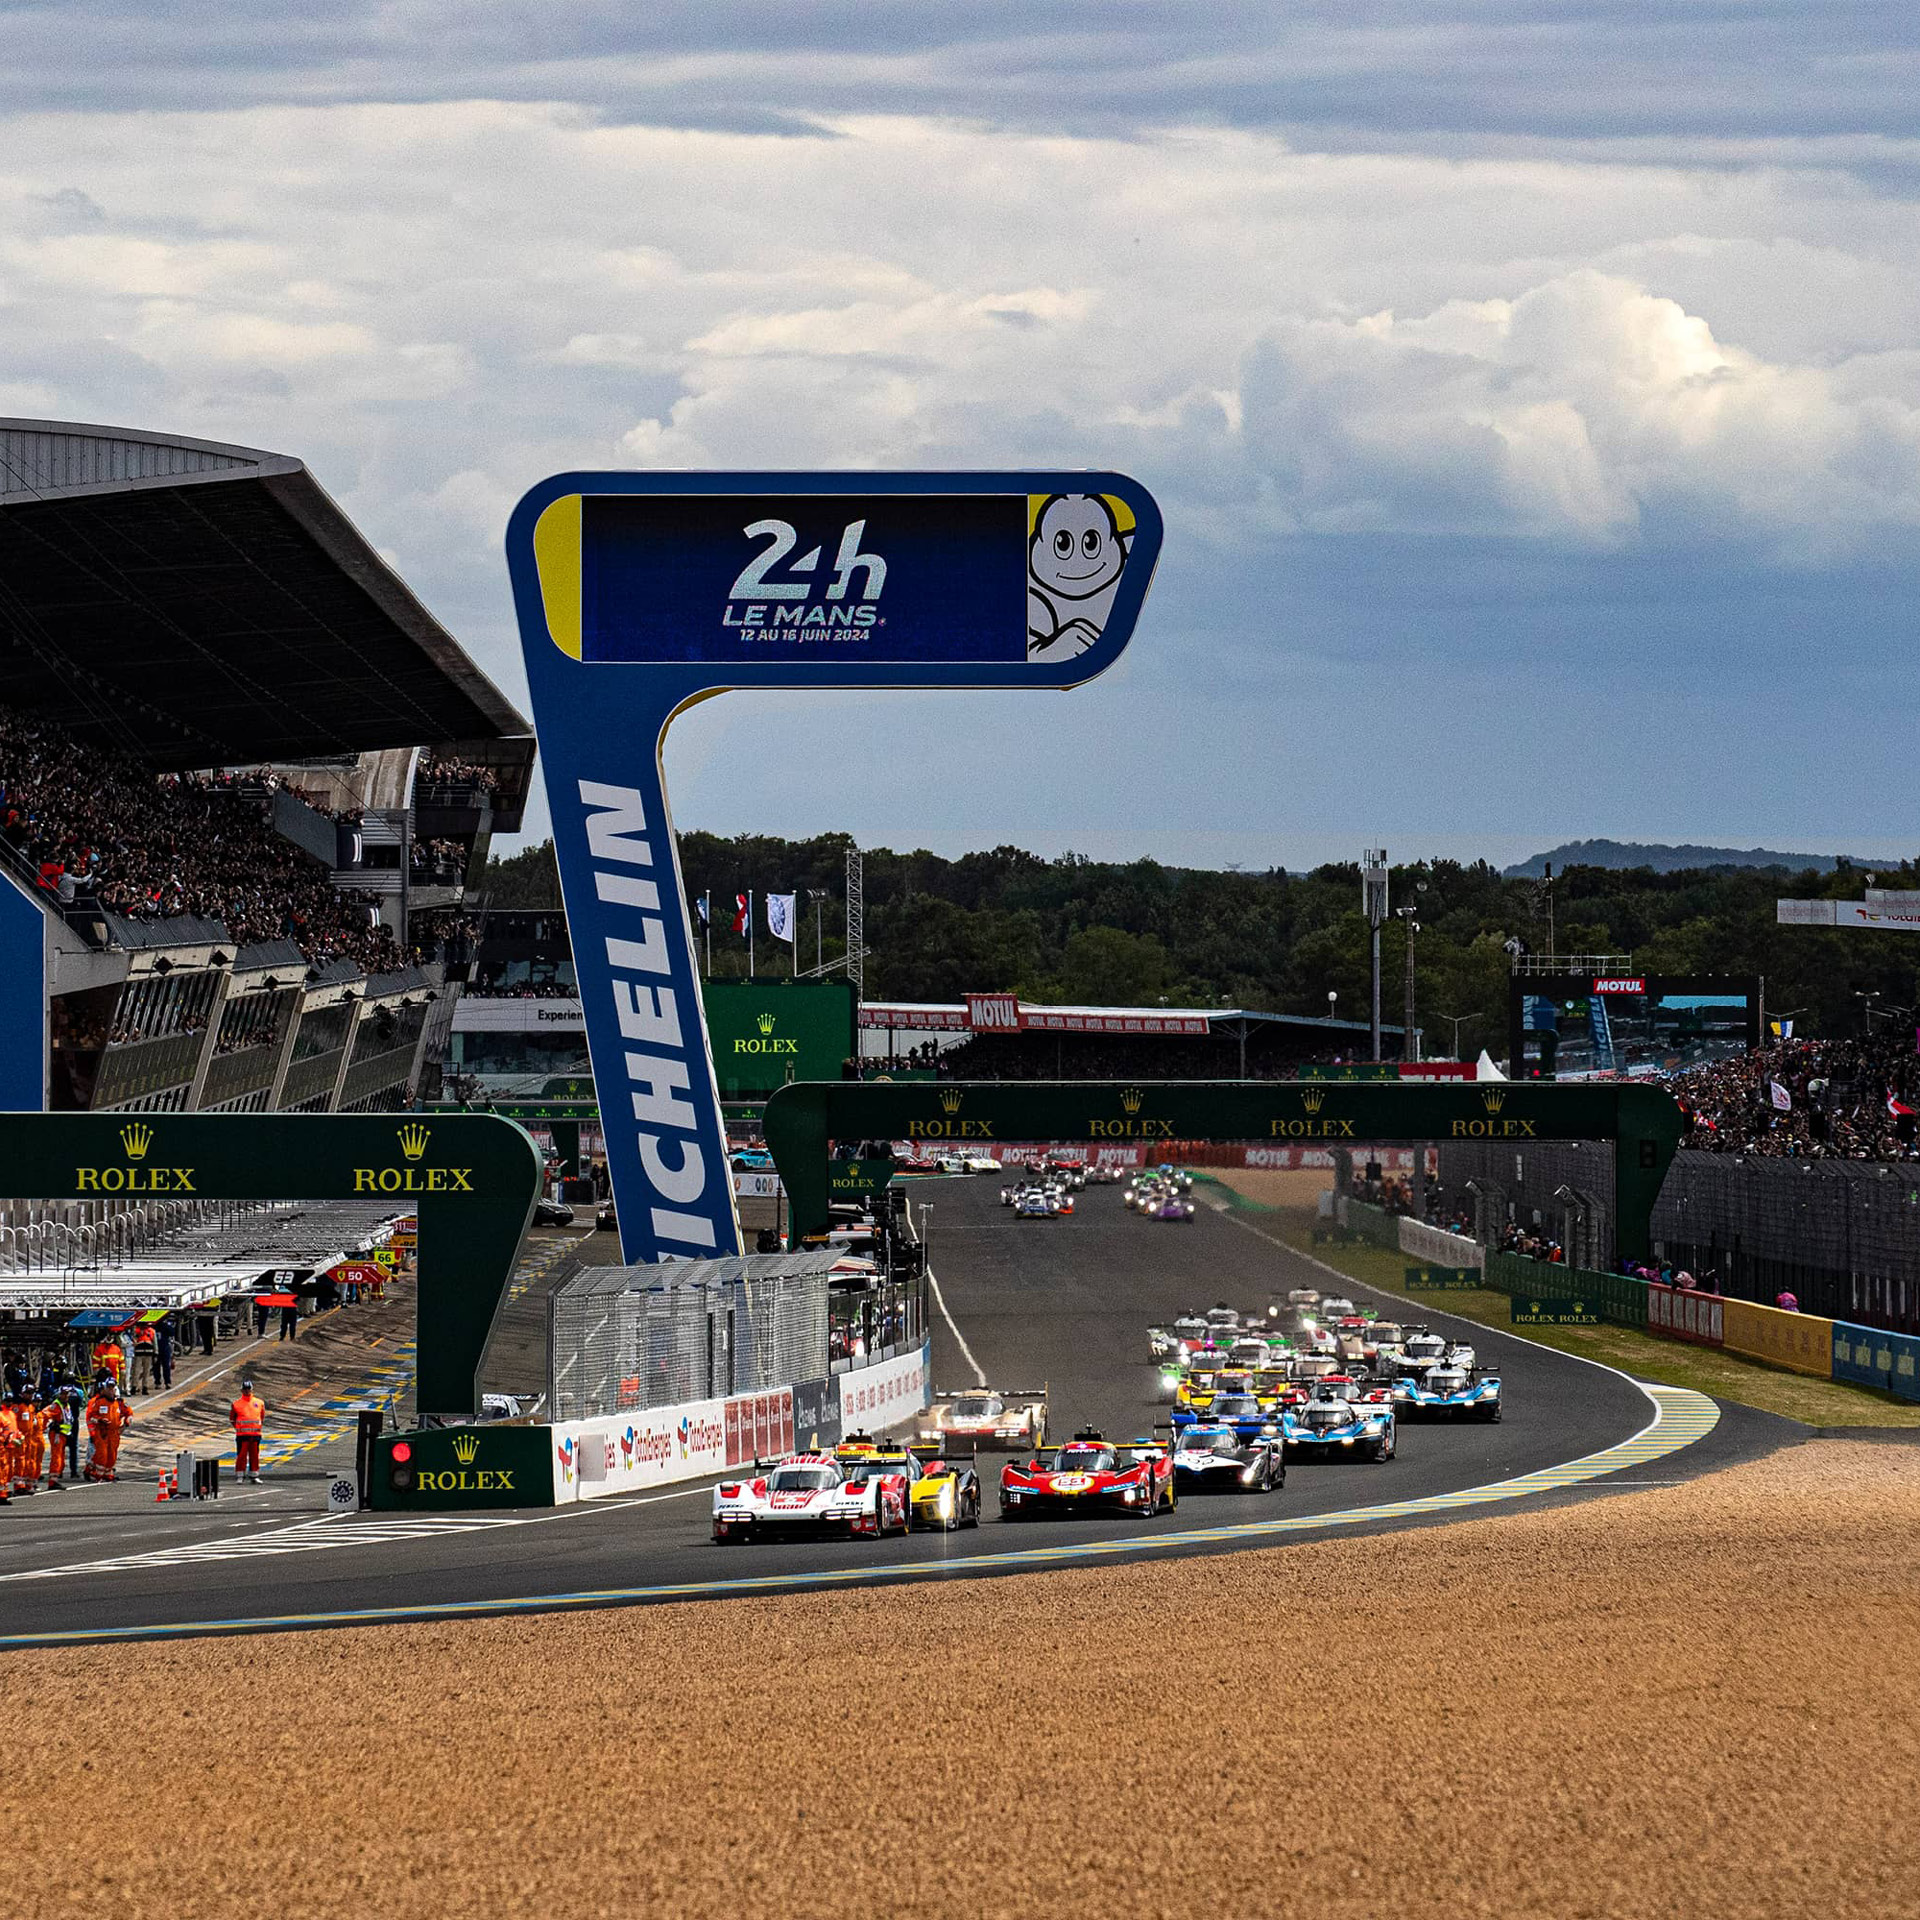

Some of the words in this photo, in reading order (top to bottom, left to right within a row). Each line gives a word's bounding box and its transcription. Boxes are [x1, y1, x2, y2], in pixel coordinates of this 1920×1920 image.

[722, 605, 768, 627] LE
[772, 605, 878, 627] MANS
[740, 629, 754, 641] 12
[757, 629, 779, 641] AU
[782, 629, 797, 641] 16
[799, 629, 831, 643] JUIN
[833, 629, 870, 641] 2024
[1596, 981, 1642, 991] MOTUL
[971, 999, 1018, 1027] MOTUL
[578, 779, 718, 1264] ICHELIN
[734, 1039, 799, 1053] ROLEX
[909, 1121, 994, 1136] ROLEX
[1089, 1120, 1174, 1136] ROLEX
[1271, 1120, 1355, 1136] ROLEX
[1452, 1120, 1536, 1136] ROLEX
[75, 1168, 196, 1191] ROLEX
[353, 1168, 474, 1191] ROLEX
[832, 1179, 874, 1188] ROLEX
[377, 1252, 392, 1263] 66
[348, 1271, 363, 1281] 50
[1516, 1314, 1555, 1323] ROLEX
[1559, 1314, 1597, 1323] ROLEX
[633, 1424, 671, 1468] TotalEnergies
[688, 1416, 723, 1458] TotalEnergies
[417, 1471, 515, 1490] ROLEX
